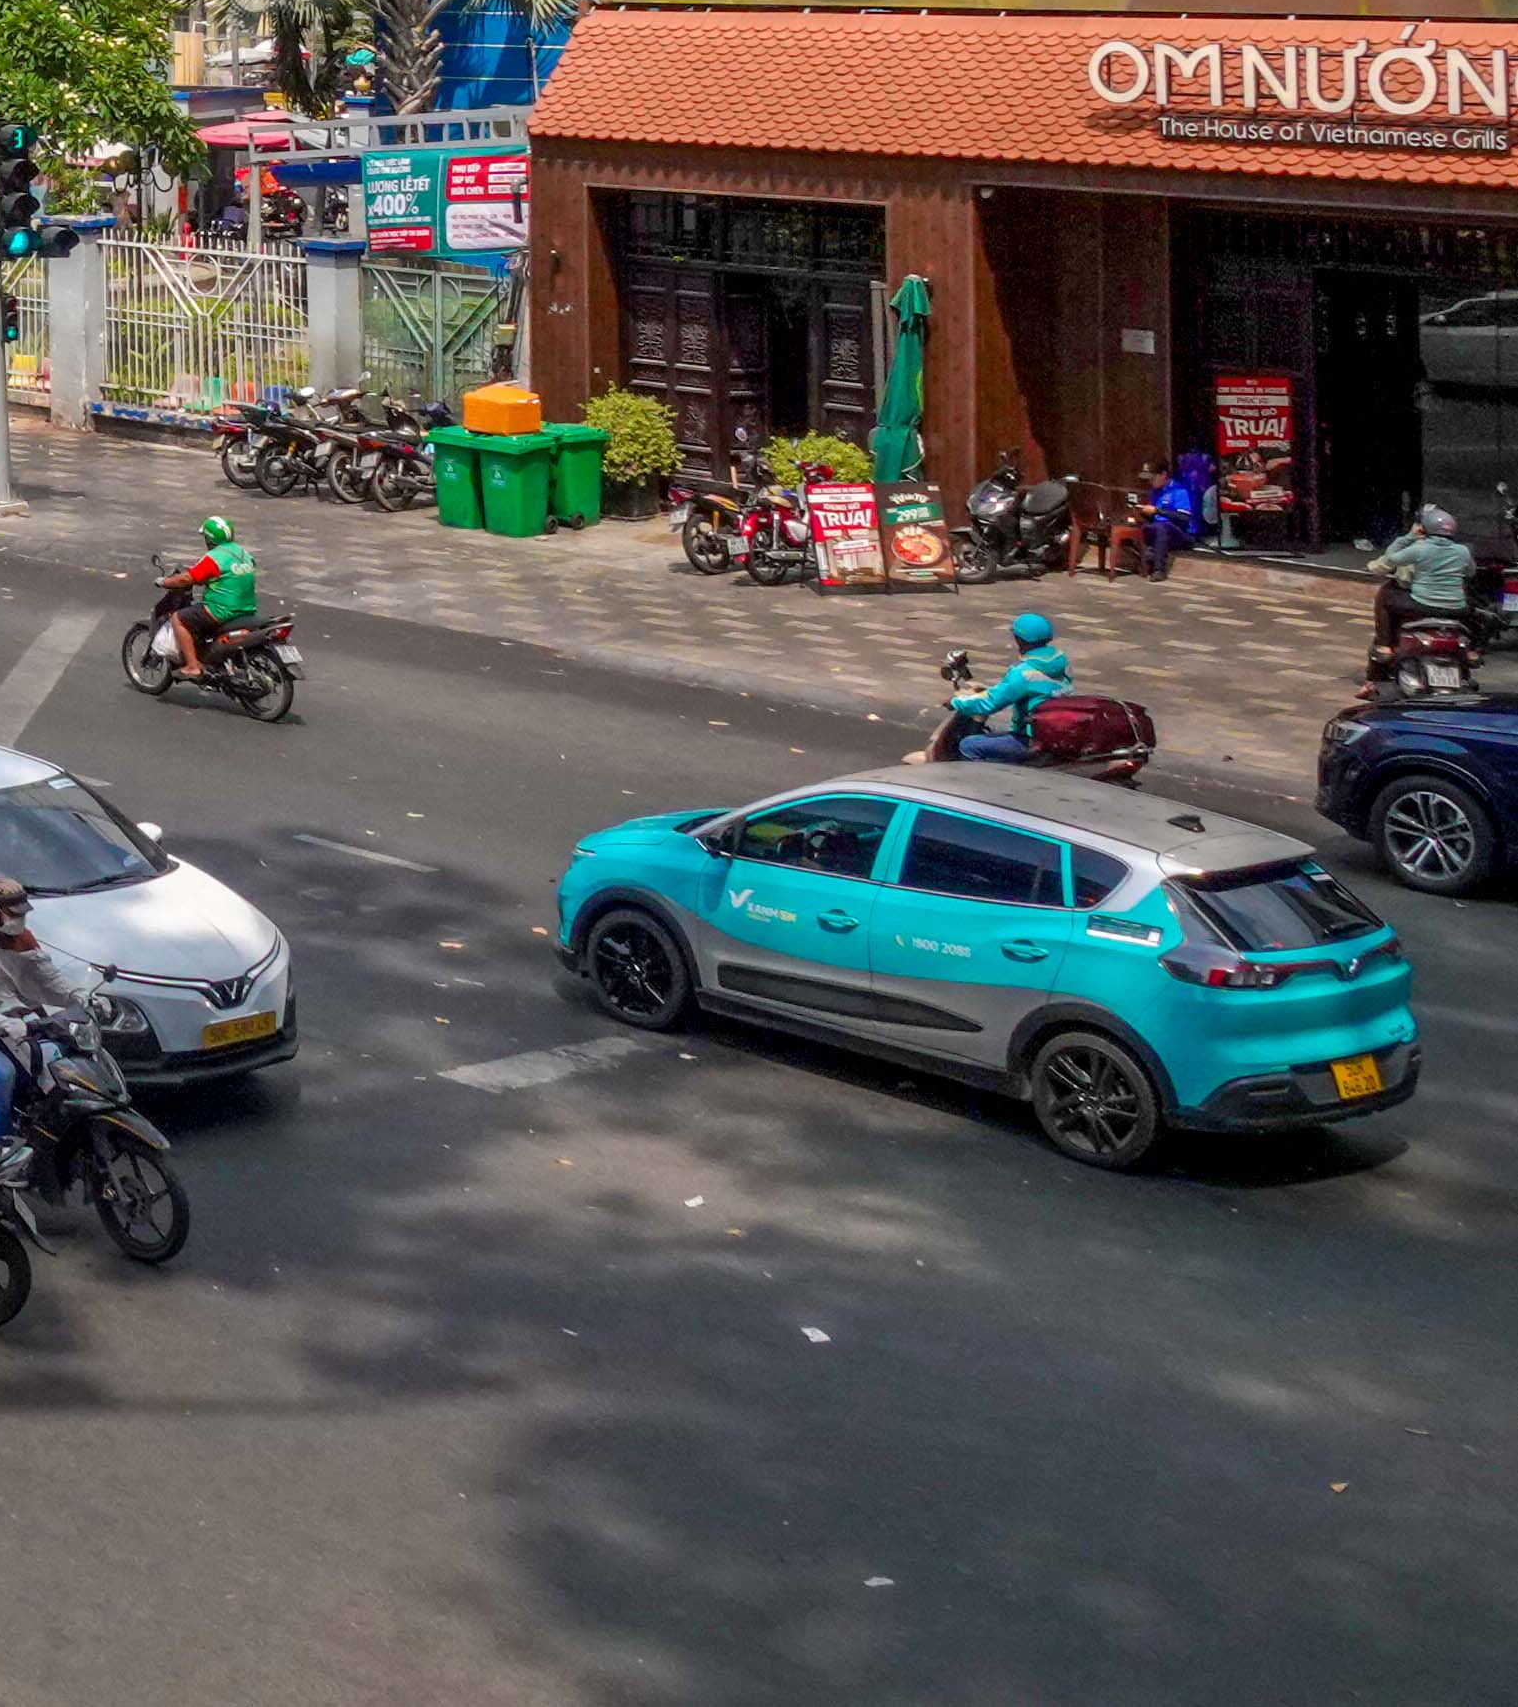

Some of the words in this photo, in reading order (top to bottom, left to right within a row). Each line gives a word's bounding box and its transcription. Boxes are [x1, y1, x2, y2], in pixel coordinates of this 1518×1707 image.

[1242, 24, 1518, 117] NƯỚN
[1158, 116, 1201, 137] The
[1204, 119, 1273, 141] House
[1281, 121, 1307, 141] of
[1309, 122, 1447, 149] Vietnamese
[1452, 128, 1508, 151] Grills
